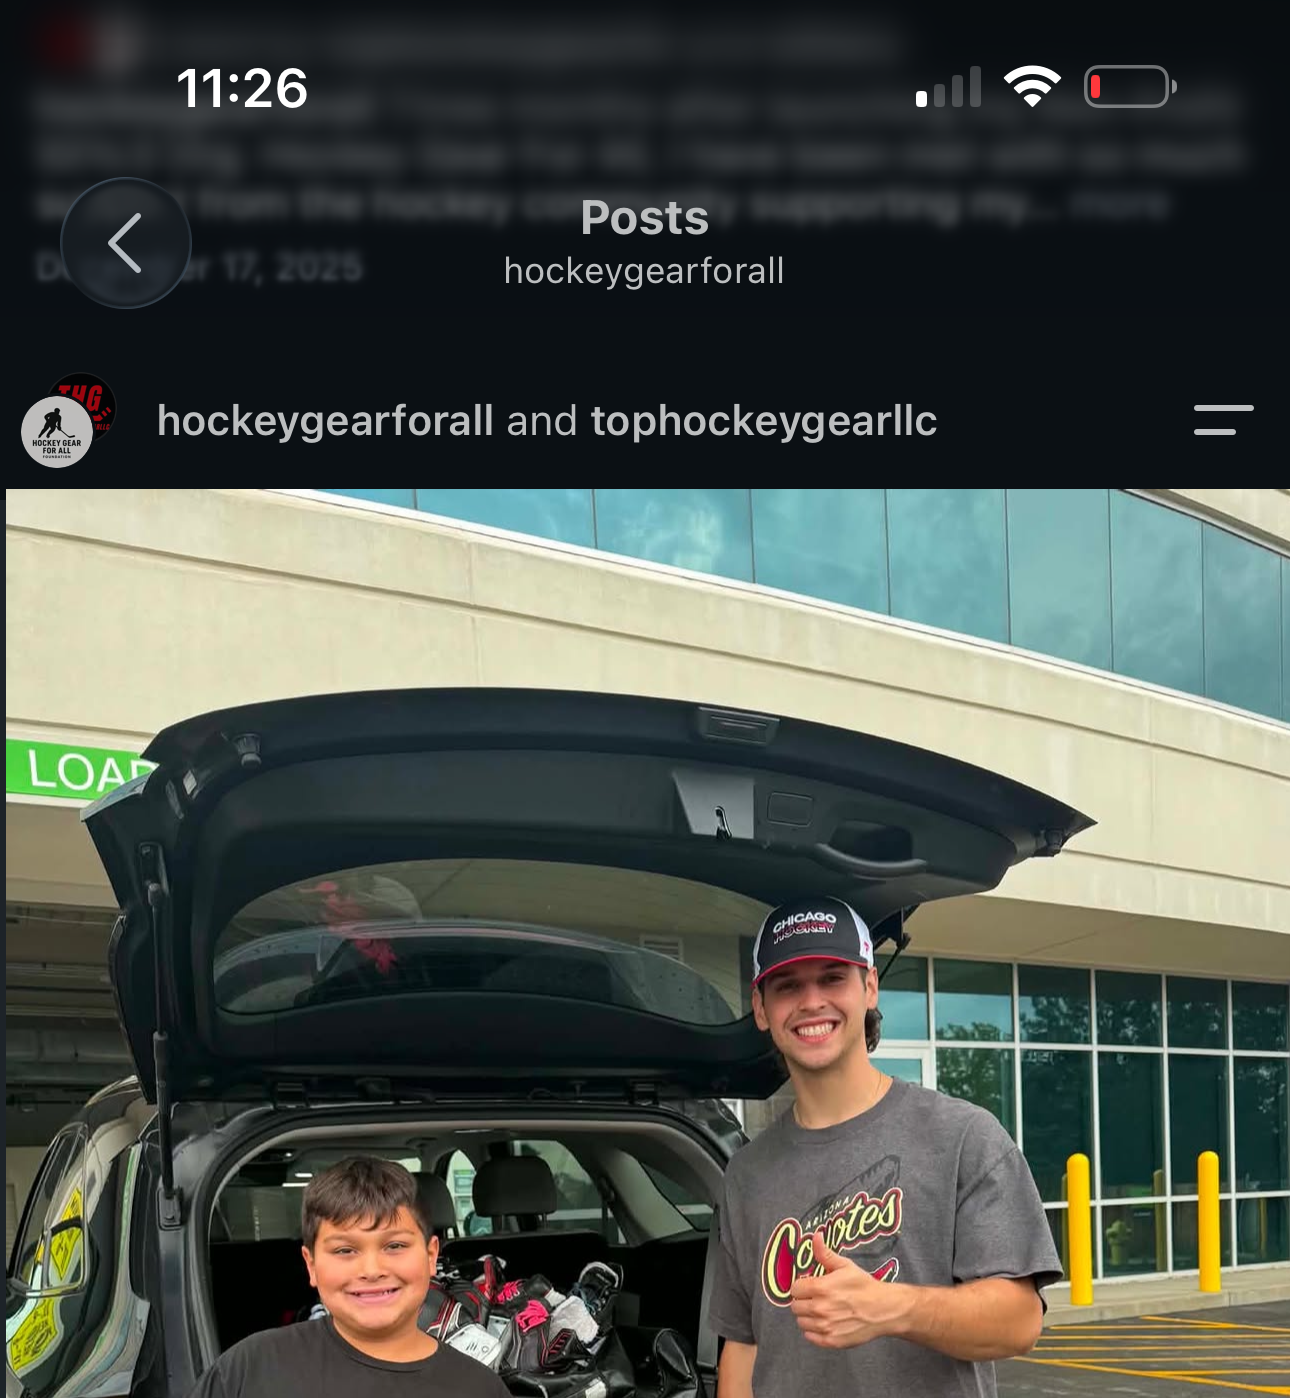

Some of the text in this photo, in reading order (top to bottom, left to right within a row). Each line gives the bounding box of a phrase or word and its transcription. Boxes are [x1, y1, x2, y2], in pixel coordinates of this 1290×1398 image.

[178, 68, 307, 108] 11:26
[583, 200, 708, 235] Posts
[276, 253, 364, 283] 2025
[506, 256, 782, 290] hockeygearforall
[159, 404, 937, 443] hockeygearforall and tophockeygearllc
[32, 439, 82, 447] HOCKEY GEAR
[773, 911, 837, 933] CHICAGO
[773, 922, 834, 944] HOCKEY
[805, 1196, 849, 1230] ARIZONA
